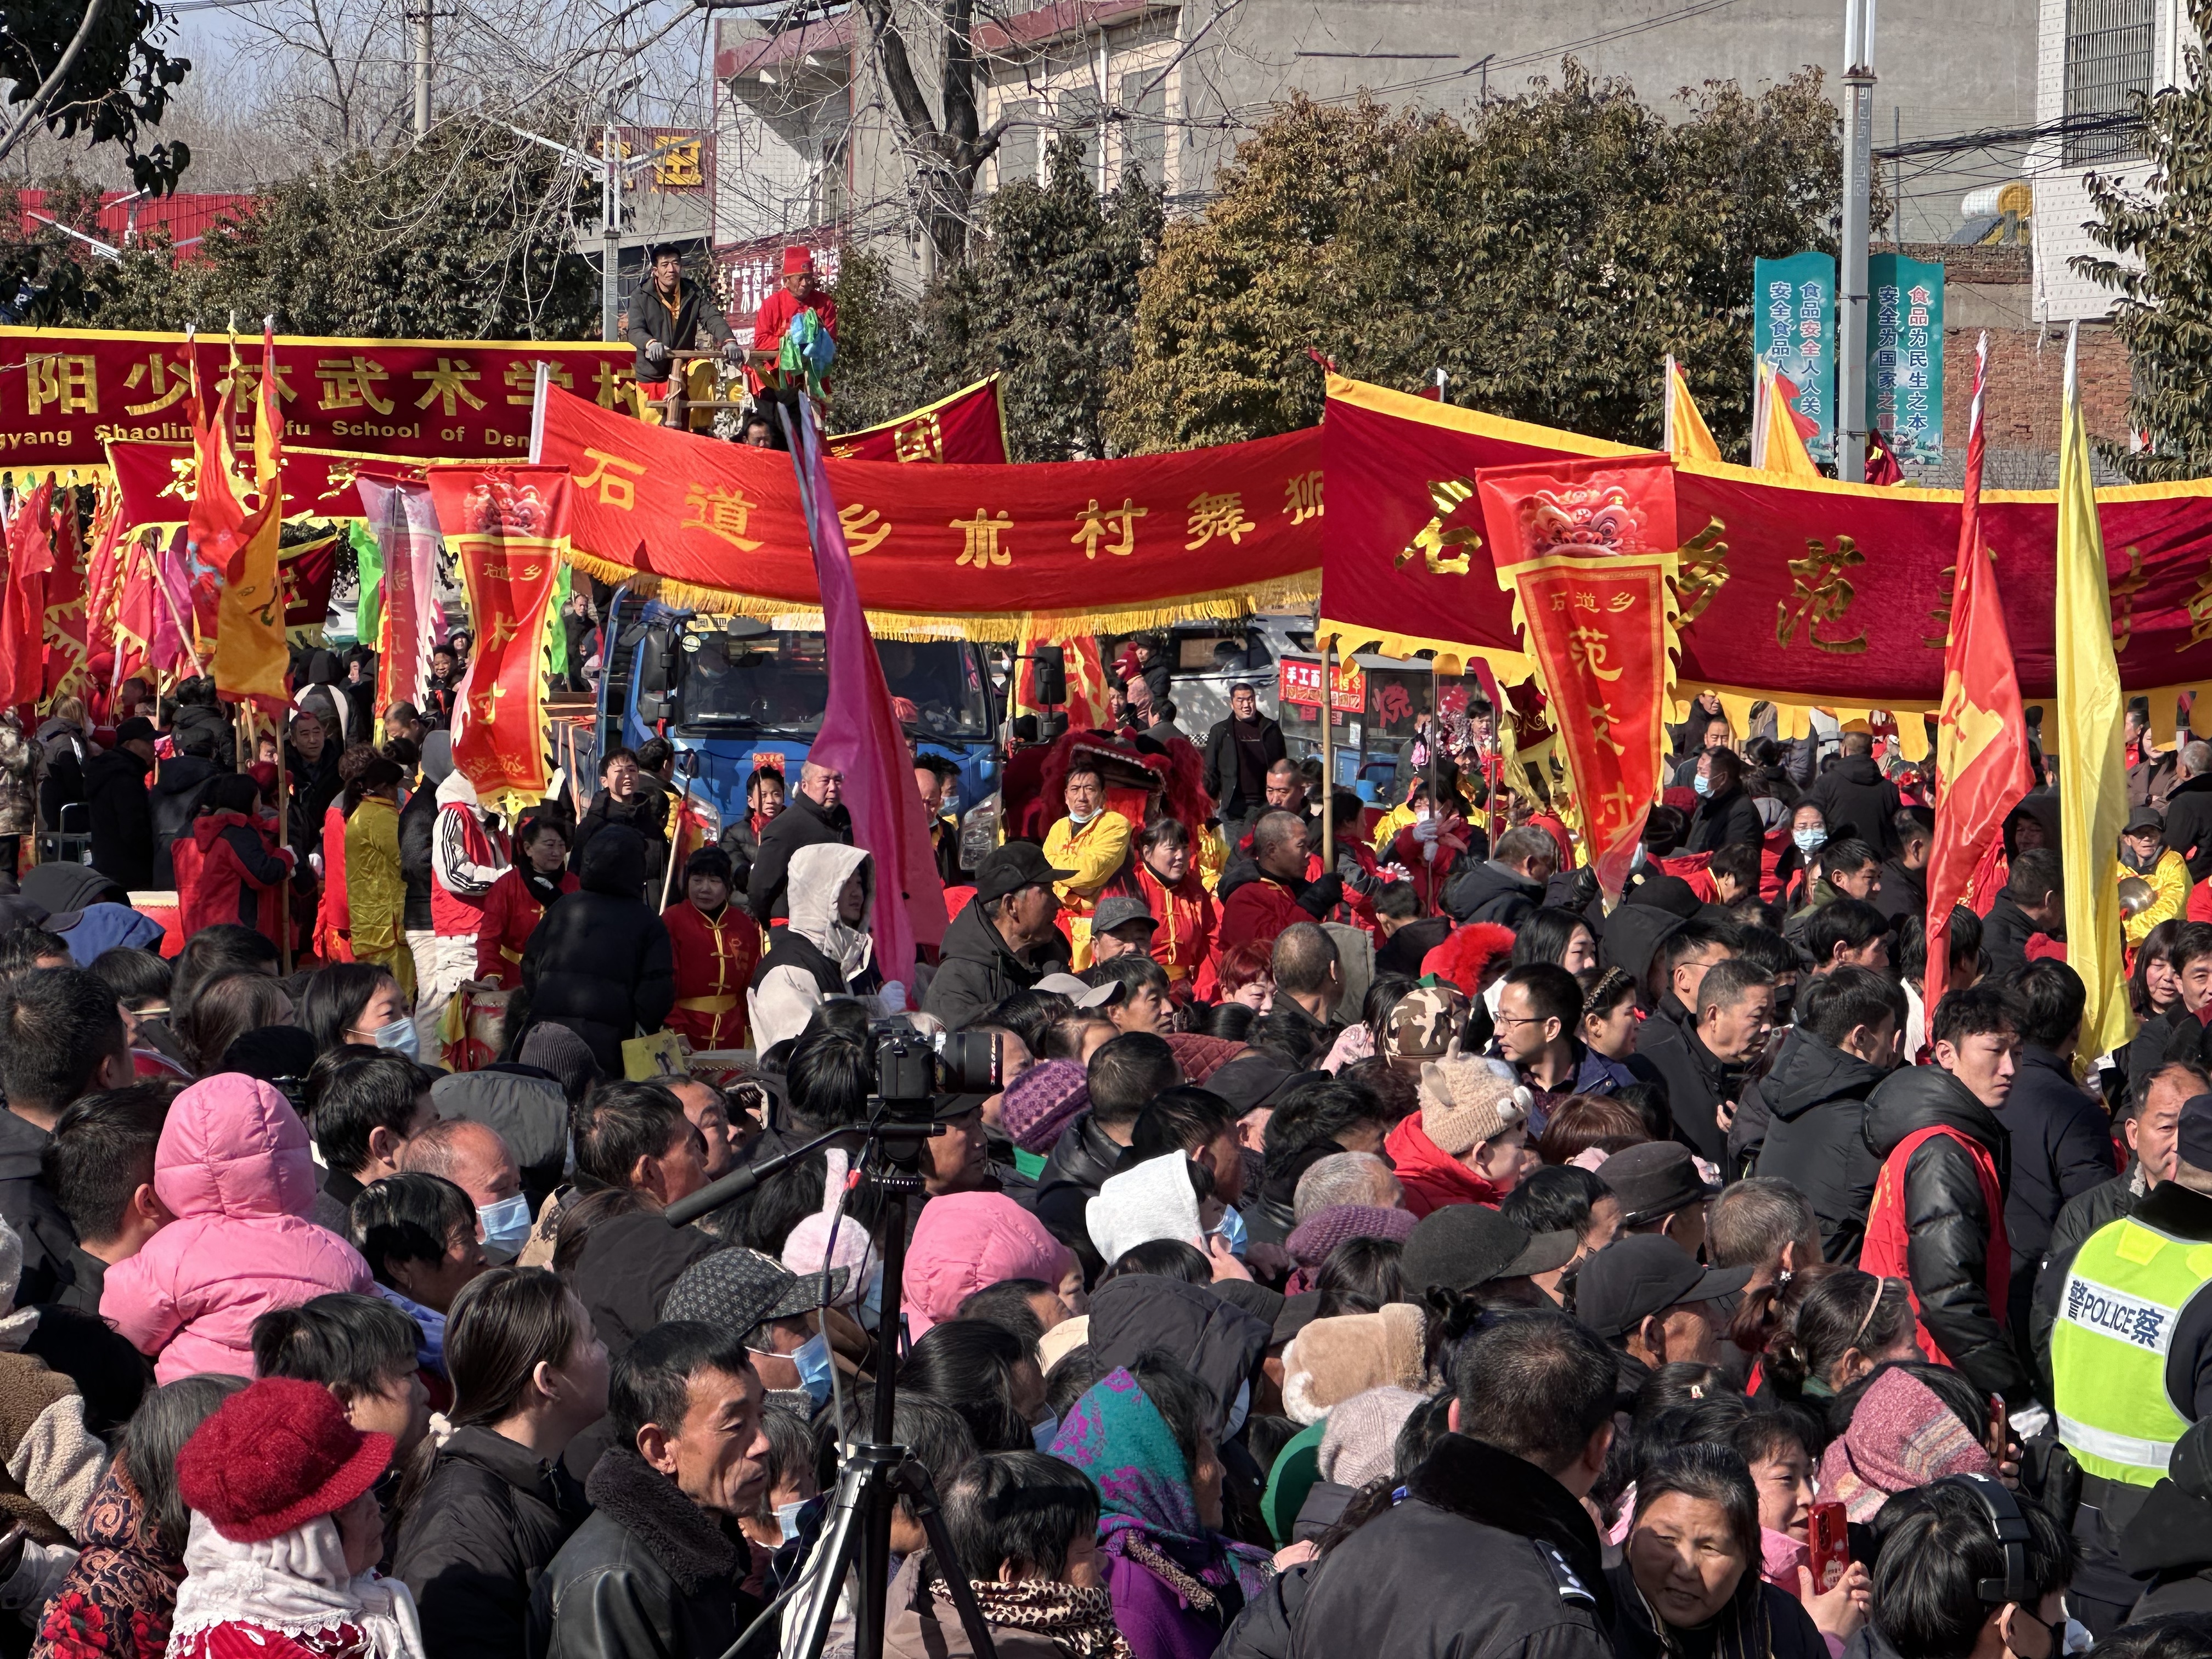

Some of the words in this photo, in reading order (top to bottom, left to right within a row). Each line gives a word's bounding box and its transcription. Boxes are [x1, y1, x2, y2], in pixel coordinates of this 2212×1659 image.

[1799, 281, 1822, 430] 食品安全人人关
[1877, 286, 1899, 431] 安全为国家之重
[1906, 285, 1930, 432] 食品为民生之本
[94, 422, 194, 441] Shaolin
[332, 420, 420, 438] School
[441, 426, 465, 442] of
[1551, 591, 1636, 613] 石道乡
